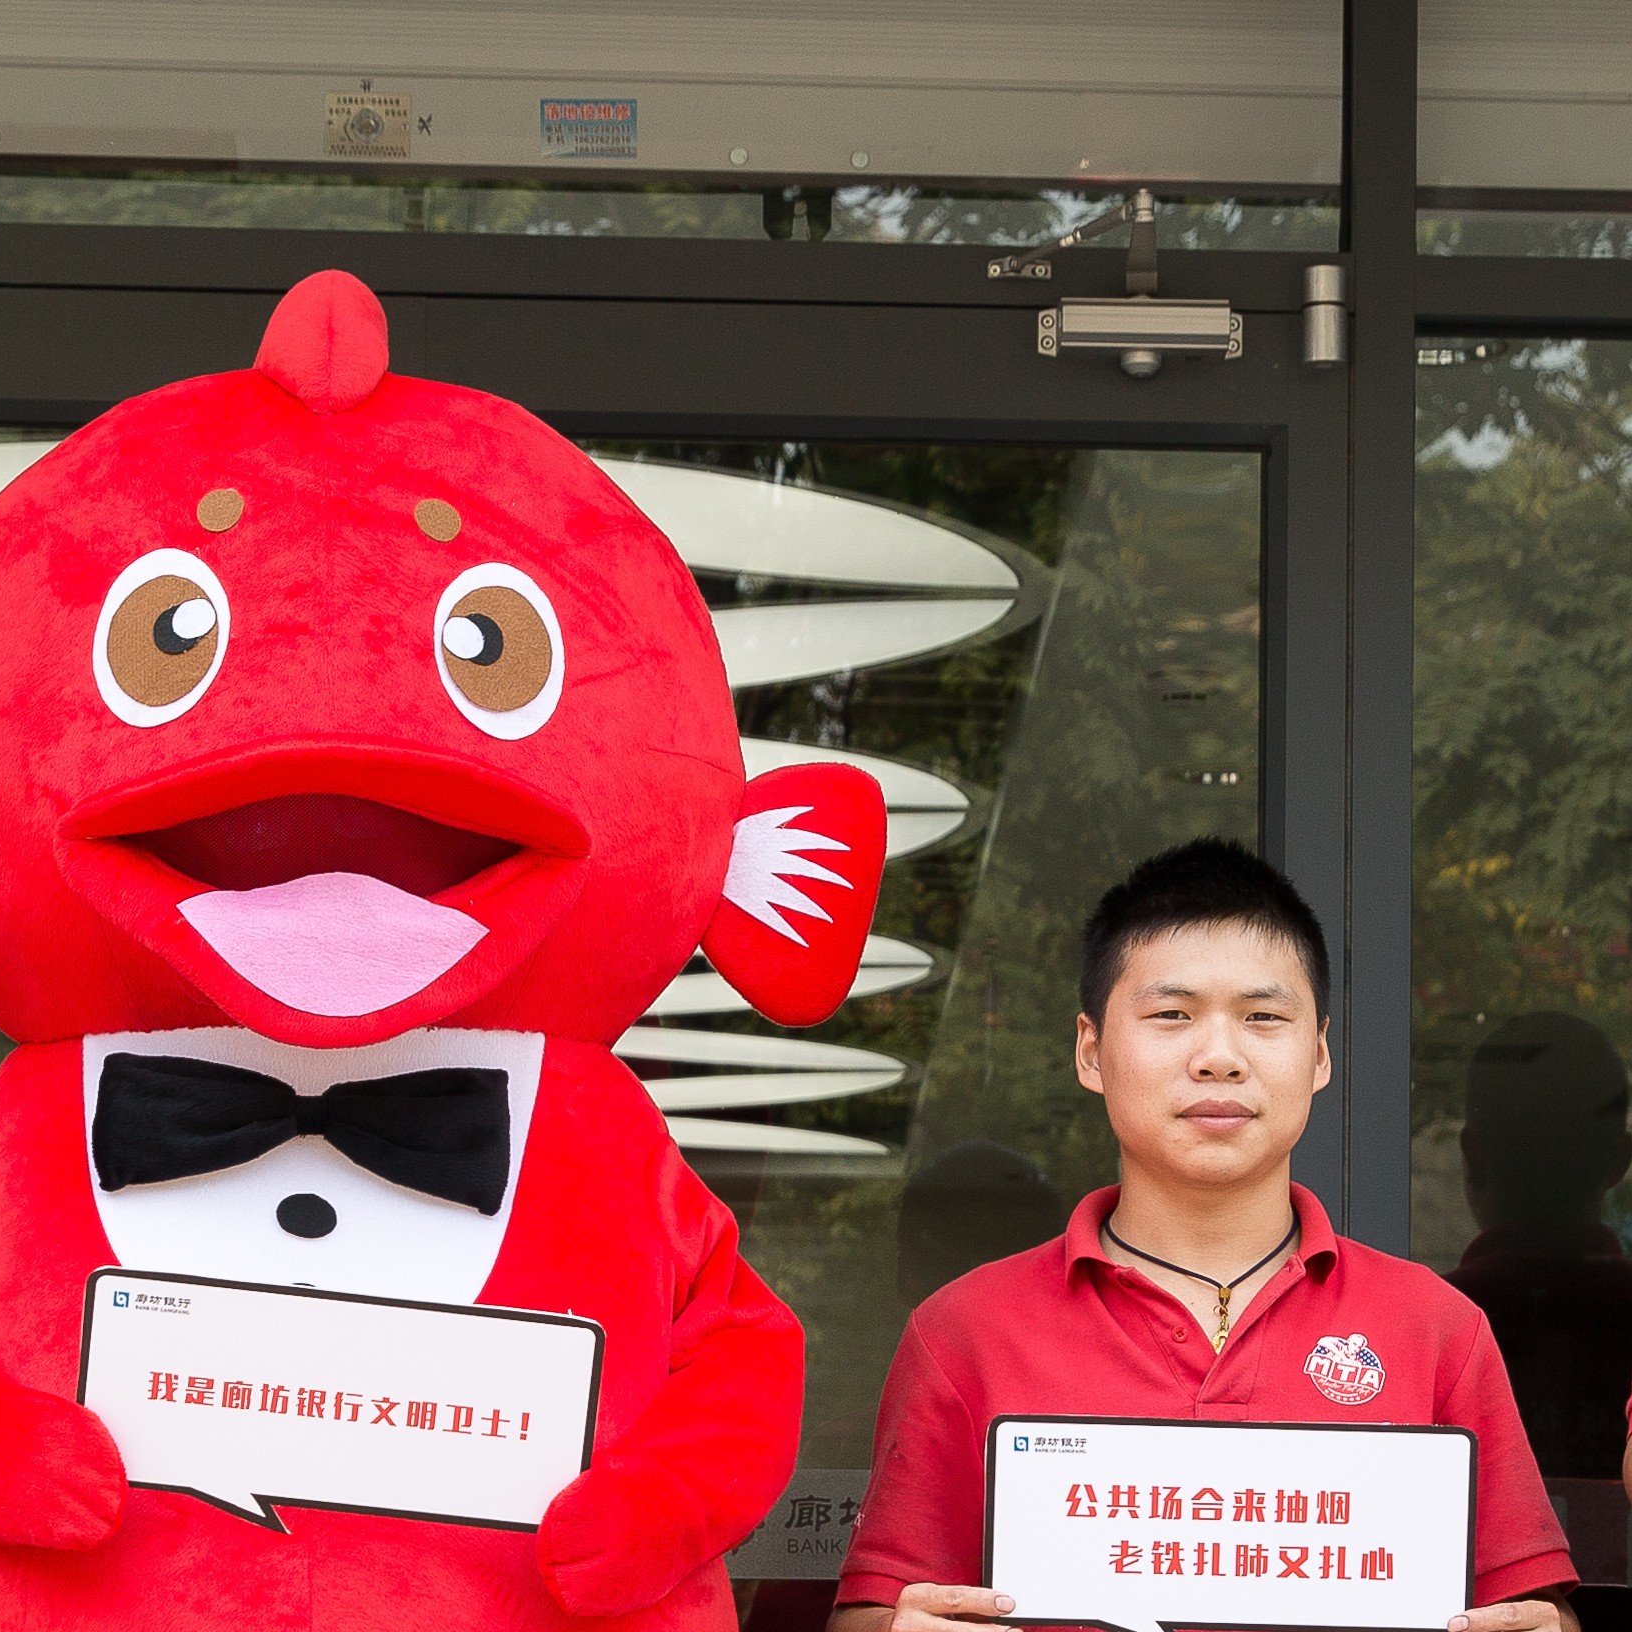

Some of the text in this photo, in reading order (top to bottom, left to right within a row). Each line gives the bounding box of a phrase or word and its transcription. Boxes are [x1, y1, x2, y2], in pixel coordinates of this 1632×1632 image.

[135, 1293, 191, 1308] 廊坊银行
[1307, 1355, 1380, 1390] MTA
[1034, 1437, 1087, 1448] 廊坊银行
[1065, 1483, 1351, 1525] 公共场合来抽烟
[787, 1538, 843, 1554] BANK
[1109, 1540, 1394, 1581] 老铁扎肺又扎心
